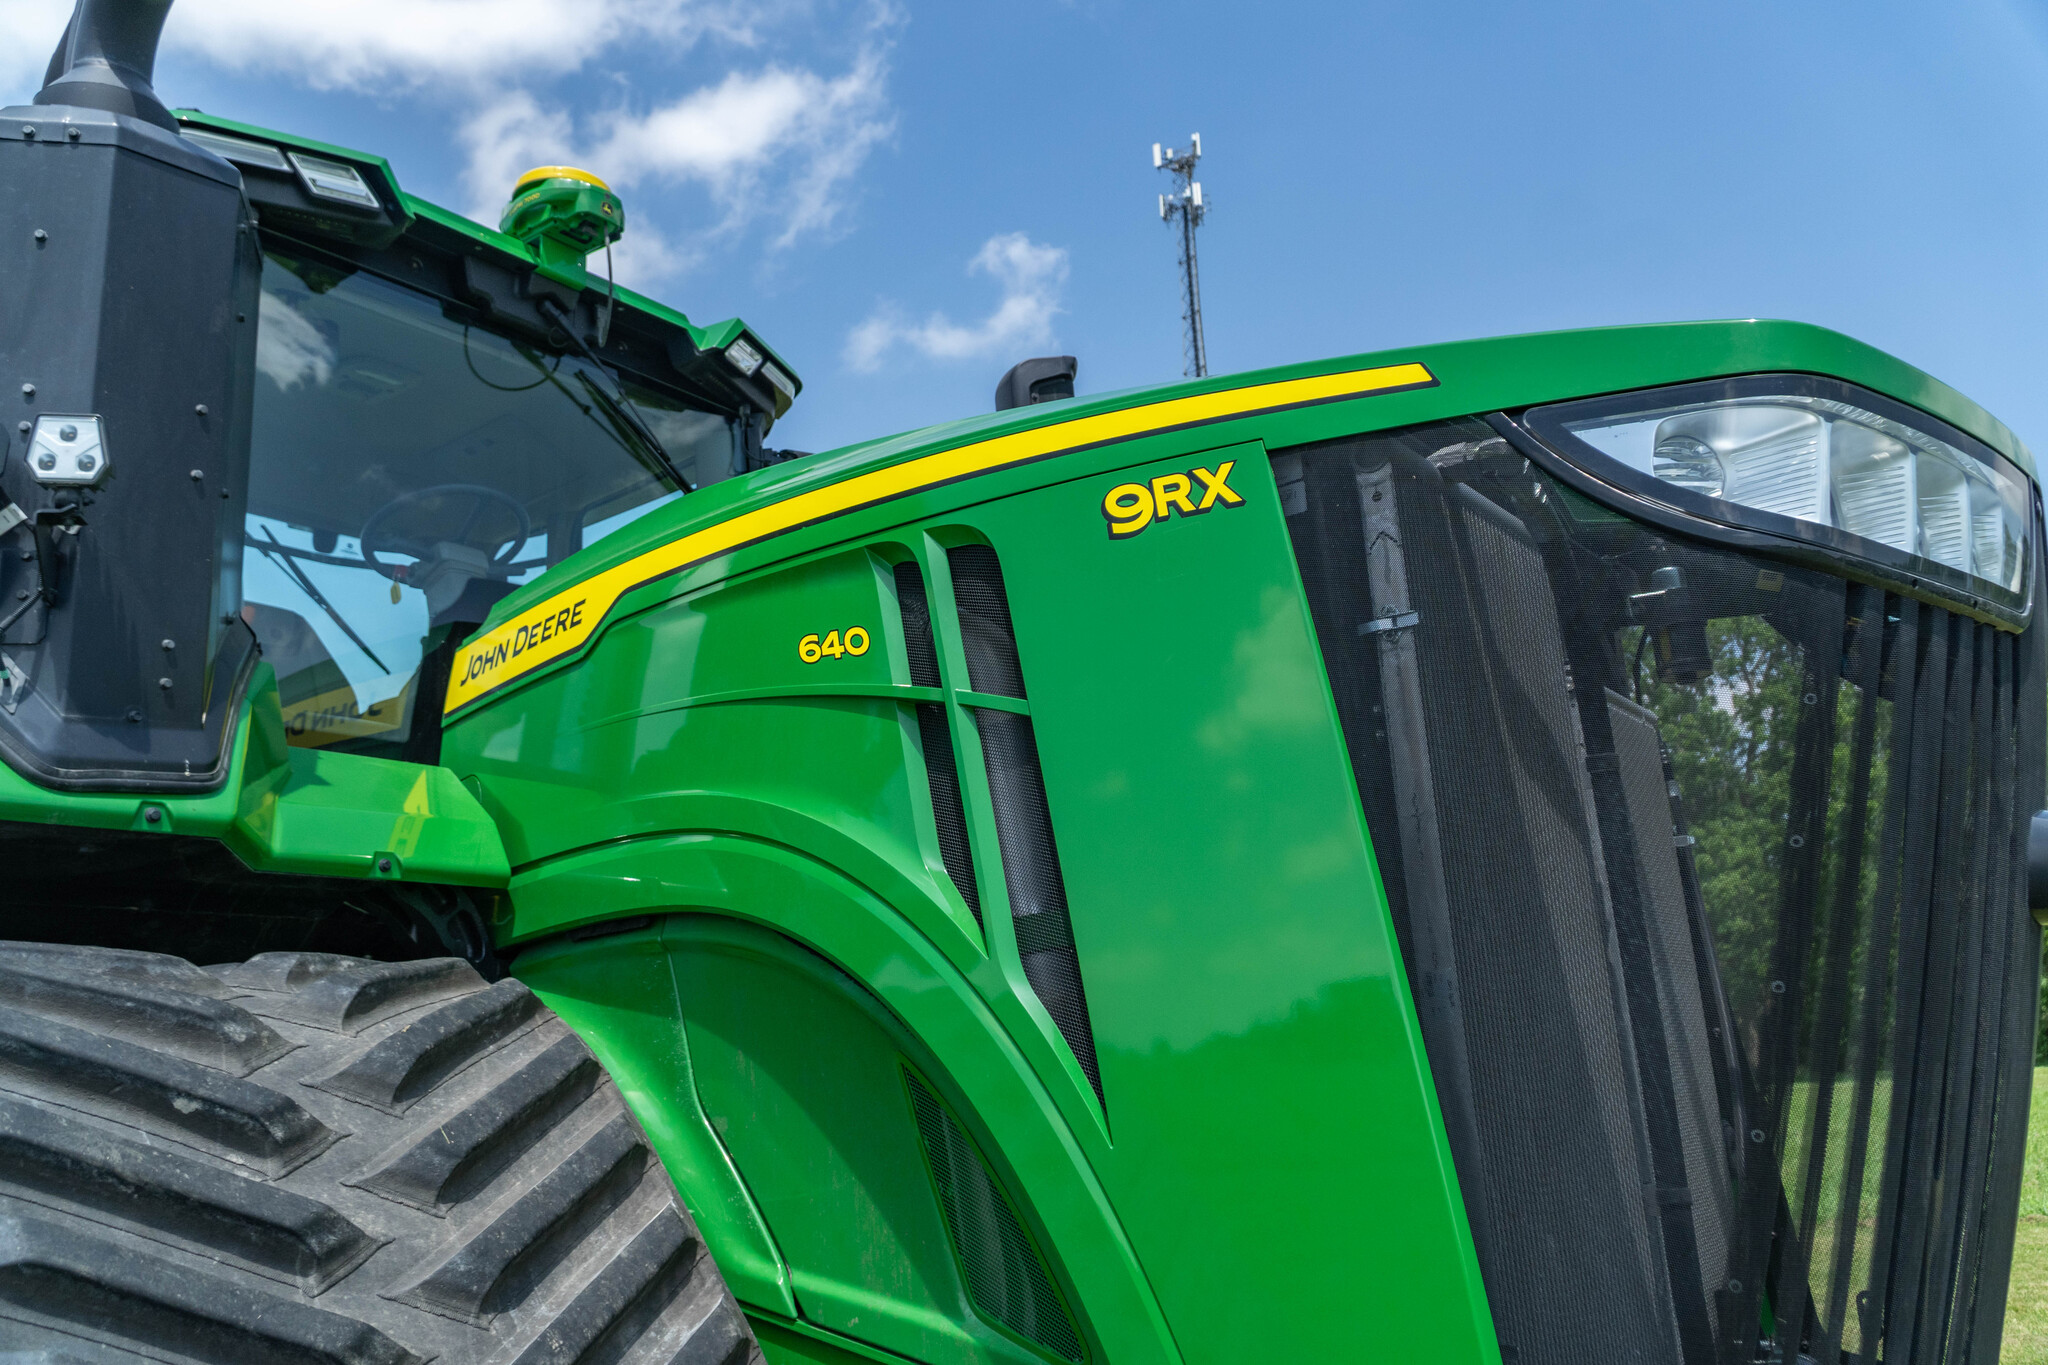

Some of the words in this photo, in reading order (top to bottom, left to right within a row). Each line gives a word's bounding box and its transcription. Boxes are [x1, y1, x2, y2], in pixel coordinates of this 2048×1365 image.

[1101, 459, 1247, 541] 9RX
[460, 638, 511, 688] JOHN
[512, 598, 587, 658] DEERE
[798, 625, 871, 665] 640
